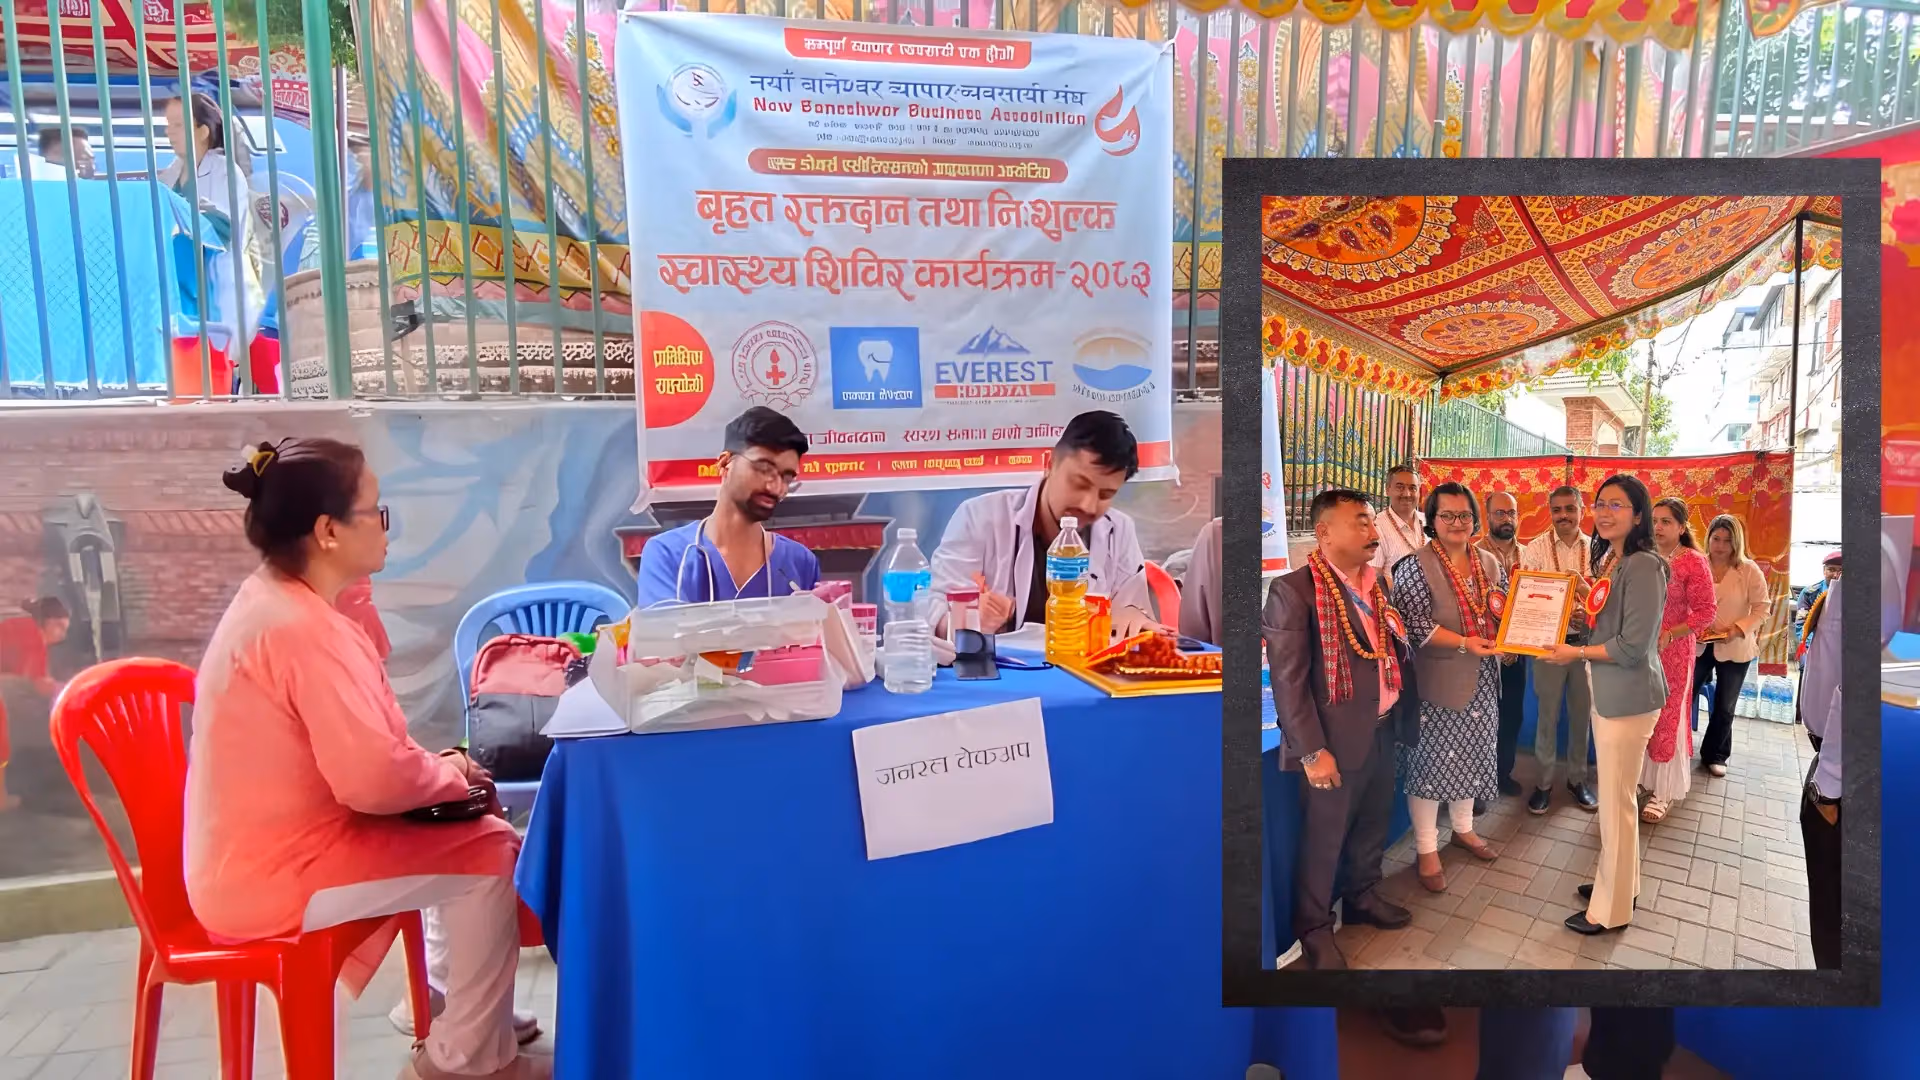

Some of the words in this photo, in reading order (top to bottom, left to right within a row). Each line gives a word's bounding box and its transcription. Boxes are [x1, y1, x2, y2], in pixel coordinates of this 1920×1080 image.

[750, 69, 795, 92] नयाँ
[782, 193, 912, 237] रक्तदान
[915, 198, 982, 228] तथा
[657, 254, 799, 295] स्वास्थ्य
[803, 246, 915, 302] शिविर
[935, 361, 1054, 384] EVEREST
[875, 756, 949, 785] जनरल
